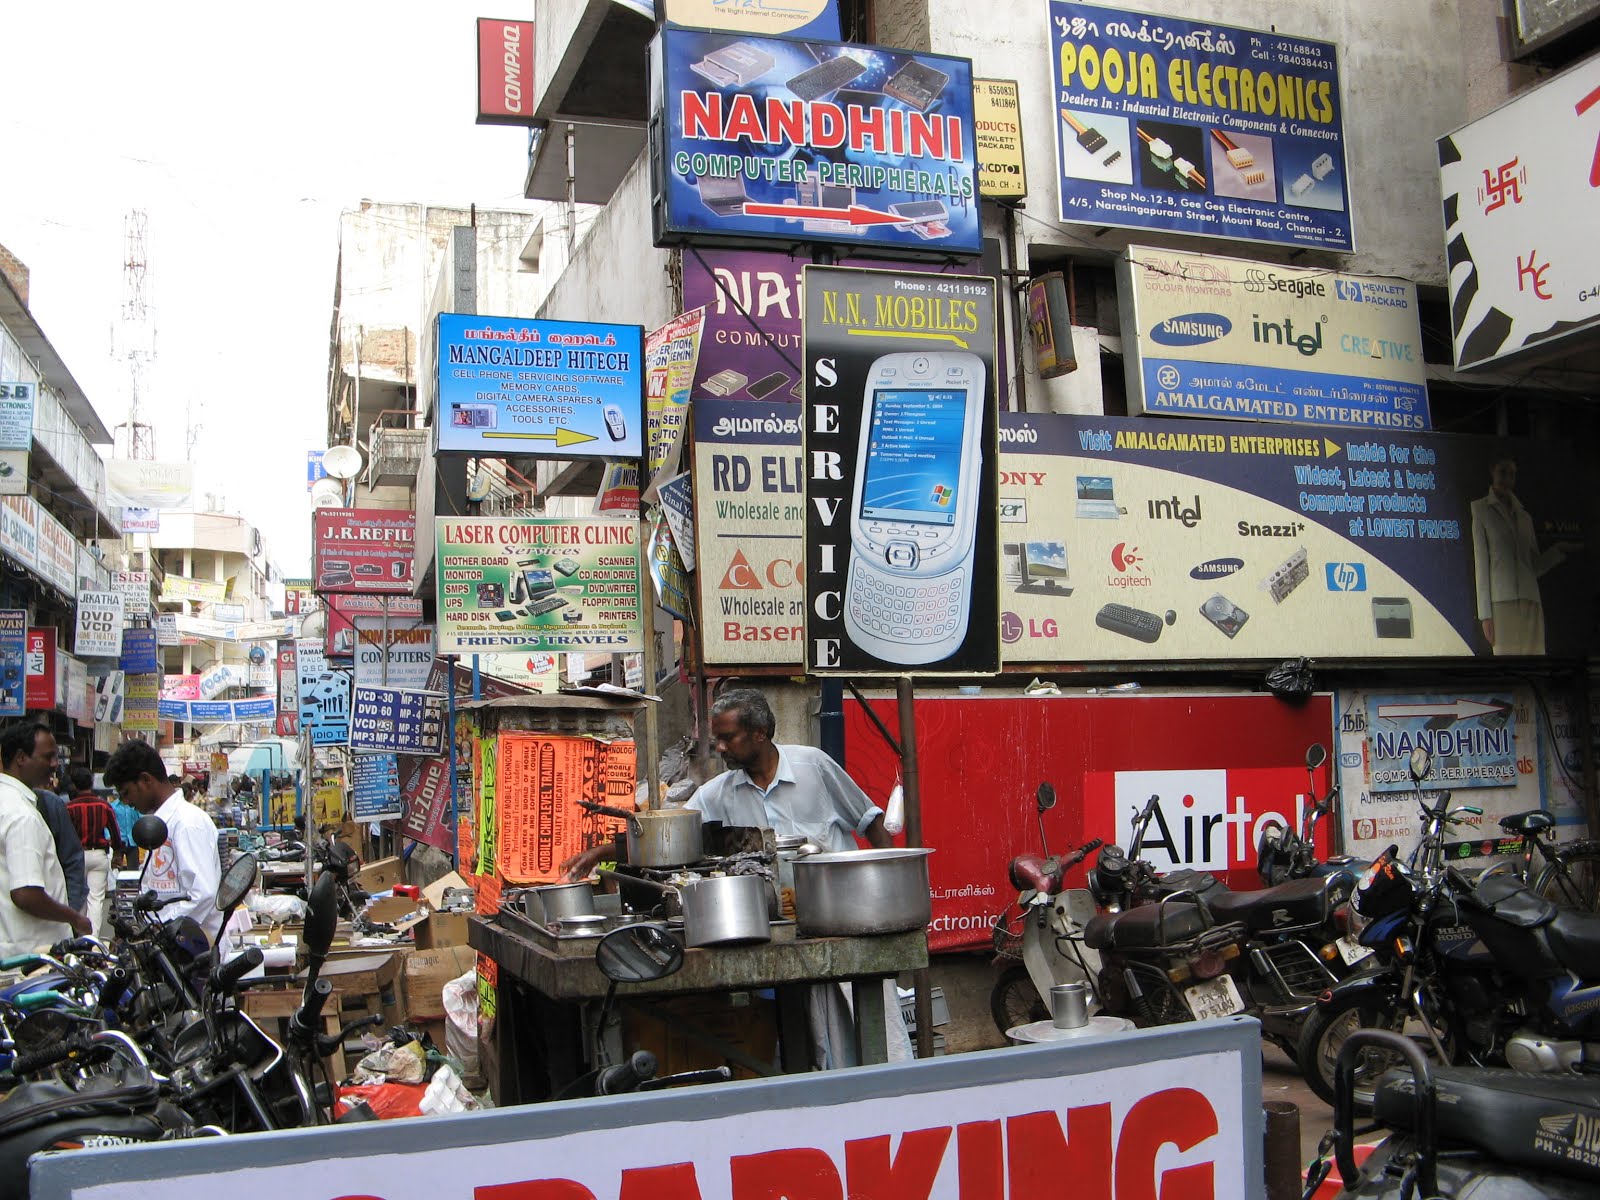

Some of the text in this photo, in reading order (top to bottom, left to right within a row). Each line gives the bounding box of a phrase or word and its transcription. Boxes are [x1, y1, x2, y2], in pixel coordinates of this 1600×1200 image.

[1276, 42, 1322, 57] 42168843
[1251, 50, 1333, 70] Cell 9840384431
[503, 25, 522, 113] COMPAQ
[988, 84, 1015, 96] 8550831
[1060, 40, 1334, 124] POOJA ELECTRONICS
[991, 98, 1016, 109] 8411869
[1060, 91, 1339, 142] Dealers Industrial Electronic Components Connectors
[681, 90, 964, 163] NANDHINI
[978, 134, 1014, 143] HEWLETT
[978, 142, 1015, 150] PACKARD
[675, 151, 973, 198] COMPUTER PERIPHERALS
[1100, 188, 1313, 224] Shop Electronic Centre,
[1068, 197, 1326, 236] 4/5, Narasingapuram Street, Mount Road, Chennai
[894, 280, 988, 296] Phone 4211 9192
[1185, 283, 1232, 297] MONITORS
[1268, 273, 1326, 299] Seagate
[1362, 284, 1406, 296] HEWLETT
[1364, 295, 1408, 308] PACKARD
[822, 290, 980, 334] N.N. MOBILES
[1163, 320, 1224, 339] SAMSUNG
[1252, 313, 1323, 356] intel
[449, 344, 630, 372] MANGALDEEP HITECH
[453, 370, 477, 379] CELL
[518, 372, 569, 382] SERVICING
[571, 374, 625, 385] SOFTWARE,
[500, 382, 580, 394] MEMORY CARDS,
[476, 392, 594, 405] DIGITAL CAMERA SPARES
[505, 404, 576, 416] ACCESSORIES,
[1154, 390, 1425, 430] AMALGAMATED ENTERPRISES
[512, 415, 570, 425] TOOLS ETC.
[1078, 428, 1320, 457] Visit AMALGAMATED ENTERPRISES
[1346, 442, 1436, 465] Inside for the
[712, 454, 751, 493] RD
[1294, 464, 1436, 490] Widest, Latest best
[716, 500, 780, 522] Wholesale
[1300, 491, 1427, 515] Computer products
[810, 358, 845, 668] SERVICE
[1148, 494, 1202, 529] intel
[445, 525, 634, 545] LASER COMPUTER CLINIC
[1366, 517, 1460, 540] LOWEST PRICES
[501, 546, 582, 556] Services
[445, 556, 509, 566] MOTHER BOARD
[598, 556, 635, 566] SCANNER
[1198, 562, 1240, 576] SAMSUNG
[445, 570, 482, 580] MONITOR
[592, 570, 636, 580] ROM DRIVE
[1107, 574, 1152, 590] Logitech
[445, 584, 470, 594] SMPS
[588, 584, 636, 594] DVD WRITER
[446, 598, 463, 608] UPS
[582, 598, 637, 608] FLOPPY DRIVE
[720, 596, 785, 616] Wholesale
[81, 610, 114, 622] DVD
[446, 612, 490, 622] HARD DISK
[598, 611, 637, 620] PRINTERS
[81, 622, 112, 632] VCD
[1029, 618, 1059, 638] LG
[456, 636, 629, 646] FRIENDS TRAVELS
[31, 636, 44, 673] Airtel
[302, 664, 324, 672] QSC
[357, 690, 376, 702] VCD
[358, 704, 378, 715] DVD
[354, 718, 376, 730] VCD
[1376, 728, 1511, 760] NANDHINI
[1343, 754, 1358, 764] NCP
[1441, 766, 1516, 780] PERIPHERALS
[408, 766, 443, 834] Hi-Zone
[504, 740, 512, 854] INSTITUTE MOBILE TECHNOLOGY
[540, 746, 554, 870] MOBILE CHIPLEVEL TRAINING
[554, 815, 563, 846] QUALITY
[474, 1087, 1218, 1200] KING
